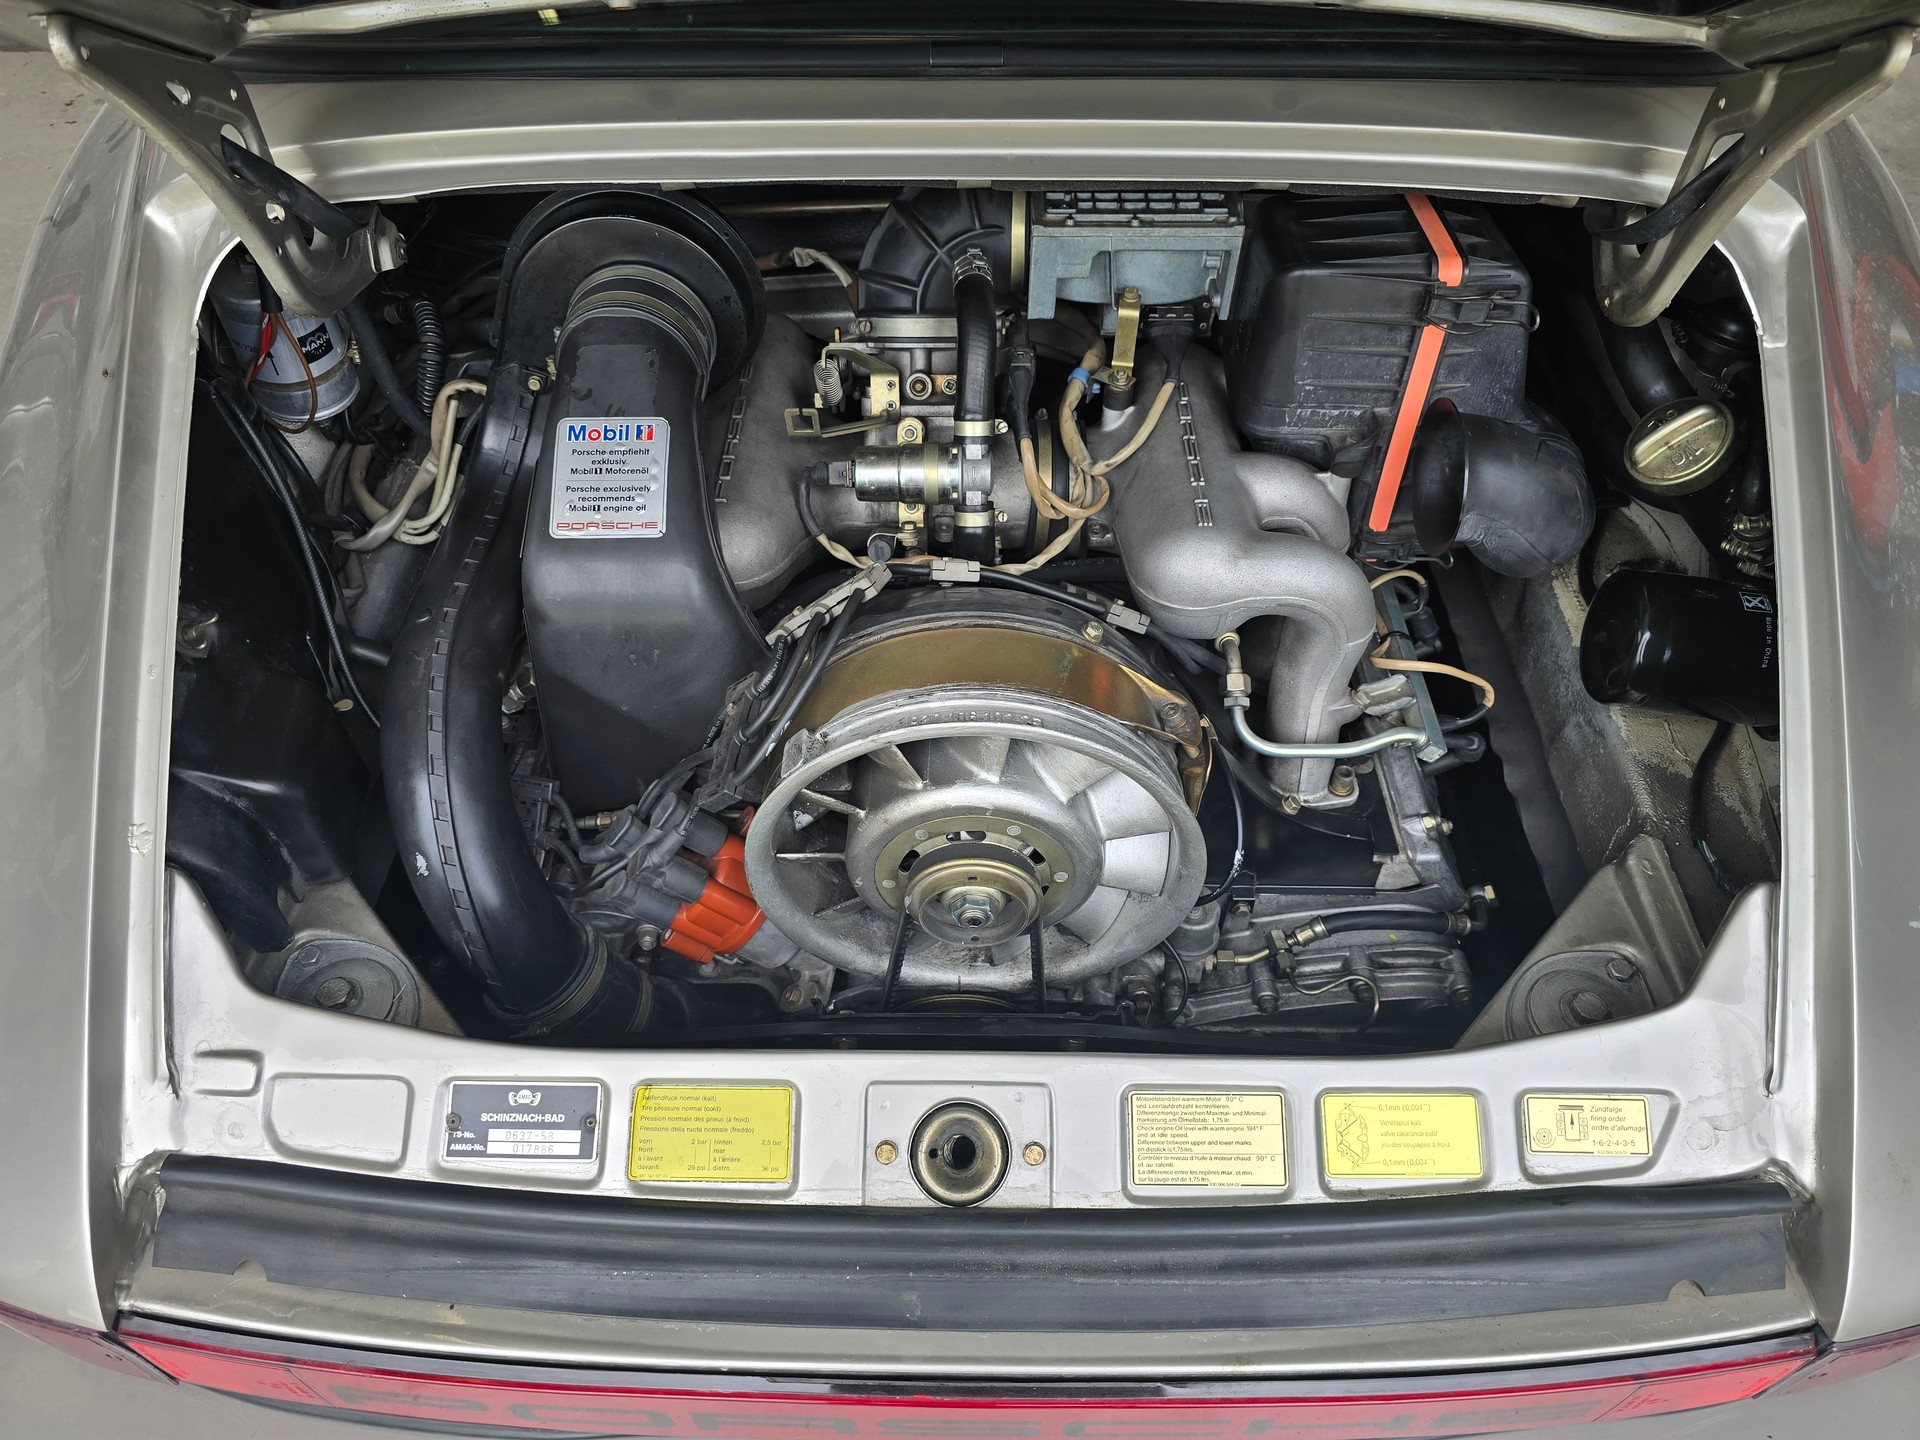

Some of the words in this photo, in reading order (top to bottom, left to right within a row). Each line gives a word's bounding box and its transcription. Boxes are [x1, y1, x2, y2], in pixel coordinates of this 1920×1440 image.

[302, 333, 329, 353] MANN
[568, 424, 630, 441] Mobil
[572, 448, 606, 456] Porsche
[608, 448, 650, 456] empfiehlt
[603, 485, 651, 494] exclusively
[568, 504, 592, 512] Mobil
[603, 504, 633, 513] engine
[557, 522, 658, 530] PORSCHE
[1766, 636, 1772, 644] in
[1762, 648, 1772, 668] China
[480, 1113, 565, 1122] SCHINZNACH-BAD
[506, 1130, 554, 1140] 0637-58
[326, 1385, 1604, 1437] PORSCHE
